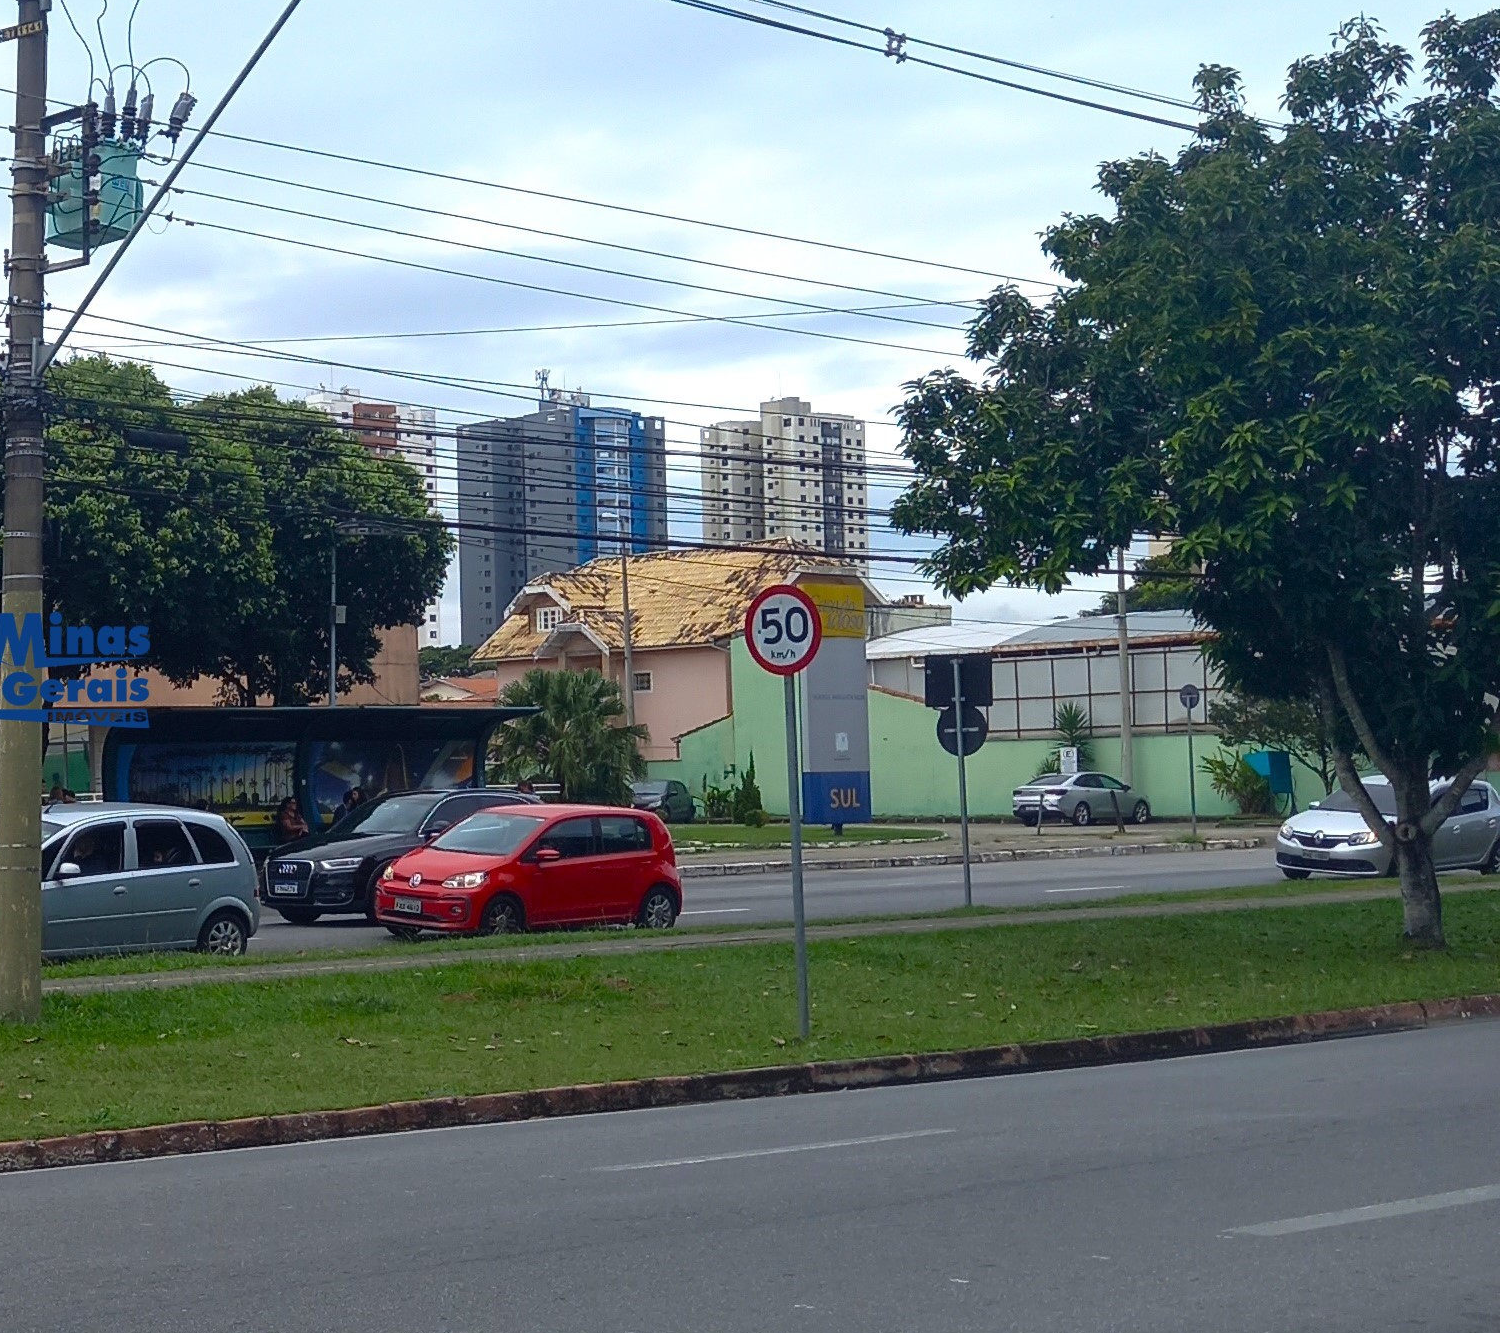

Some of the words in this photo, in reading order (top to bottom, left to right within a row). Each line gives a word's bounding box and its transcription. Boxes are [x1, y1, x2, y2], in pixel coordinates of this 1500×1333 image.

[760, 607, 809, 644] 50
[771, 649, 796, 659] km/h
[830, 788, 860, 807] SUL
